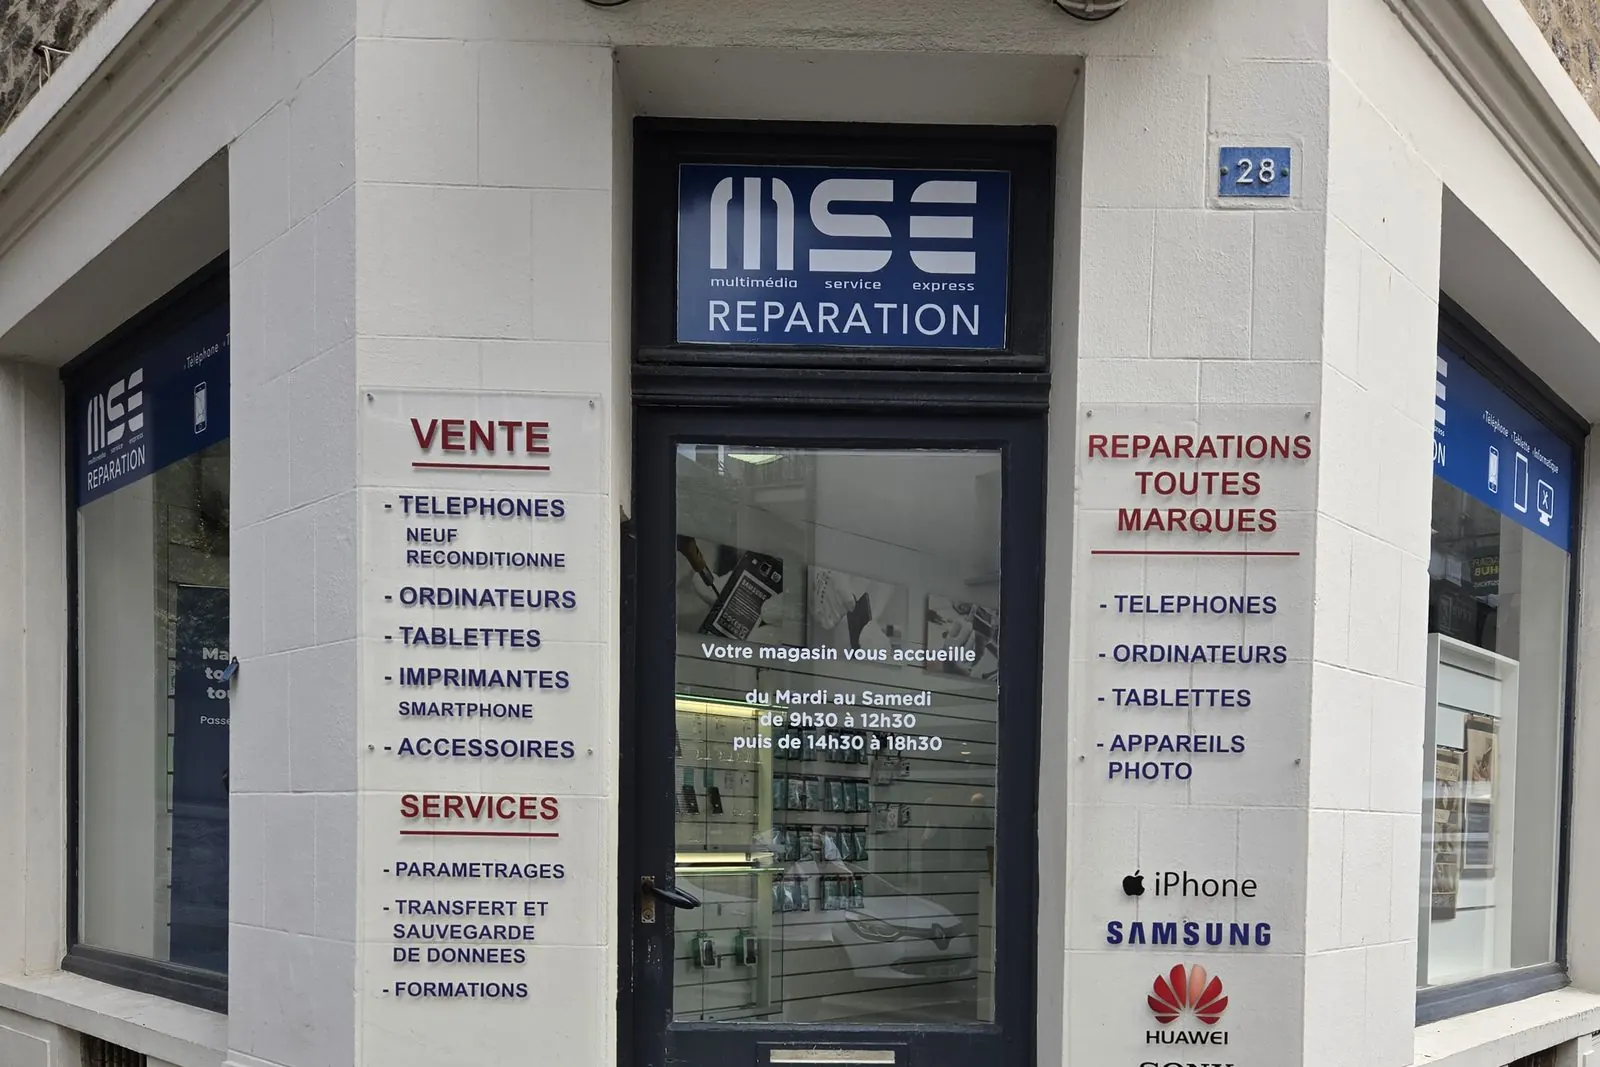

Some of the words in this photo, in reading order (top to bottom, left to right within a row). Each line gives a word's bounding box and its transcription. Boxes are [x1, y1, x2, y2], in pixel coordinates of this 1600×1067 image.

[1237, 158, 1275, 183] 28
[709, 176, 978, 274] MSE
[710, 276, 798, 288] multimédia
[824, 278, 882, 290] service
[912, 280, 975, 292] express
[709, 300, 979, 335] REPARATION
[87, 367, 144, 456] MSE
[410, 417, 550, 453] VENTE
[1088, 434, 1312, 459] REPARATIONS
[87, 444, 146, 491] REPARATION
[1134, 471, 1261, 496] TOUTES
[398, 495, 565, 518] TELEPHONES
[1118, 507, 1277, 534] MARQUES
[406, 527, 458, 543] NEUF
[406, 549, 566, 568] RECONDITIONNE
[399, 586, 577, 609] ORDINATEURS
[1114, 595, 1277, 615] TELEPHONES
[398, 626, 541, 648] TABLETTES
[701, 643, 753, 659] Votre
[759, 644, 838, 663] magasin
[843, 648, 888, 661] vous
[893, 646, 976, 662] accueille
[1113, 644, 1287, 664] ORDINATEURS
[399, 667, 570, 689] IMPRIMANTES
[745, 688, 769, 706] du
[774, 689, 829, 706] Mardi
[833, 693, 856, 705] au
[861, 690, 932, 706] Samedi
[1111, 688, 1251, 708] TABLETTES
[398, 701, 533, 719] SMARTPHONE
[758, 711, 785, 727] de
[789, 711, 838, 728] 9h30
[843, 711, 855, 728] à
[860, 712, 917, 729] 12h30
[397, 737, 575, 759] ACCESSOIRES
[733, 734, 773, 752] puis
[777, 733, 802, 749] de
[807, 734, 864, 750] 14h30
[869, 734, 881, 750] à
[886, 735, 943, 751] 18h30
[1109, 734, 1246, 754] APPAREILS
[1108, 761, 1193, 780] PHOTO
[400, 794, 559, 821] SERVICES
[395, 861, 565, 879] PARAMETRAGES
[1155, 870, 1258, 898] iPhone
[395, 899, 518, 916] TRANSFERT
[524, 901, 549, 917] ET
[393, 923, 535, 941] SAUVEGARDE
[1106, 920, 1271, 947] SAMSUNG
[393, 947, 420, 963] DE
[427, 947, 526, 964] DONNEES
[395, 981, 528, 998] FORMATIONS
[1146, 1030, 1229, 1045] HUAWEI
